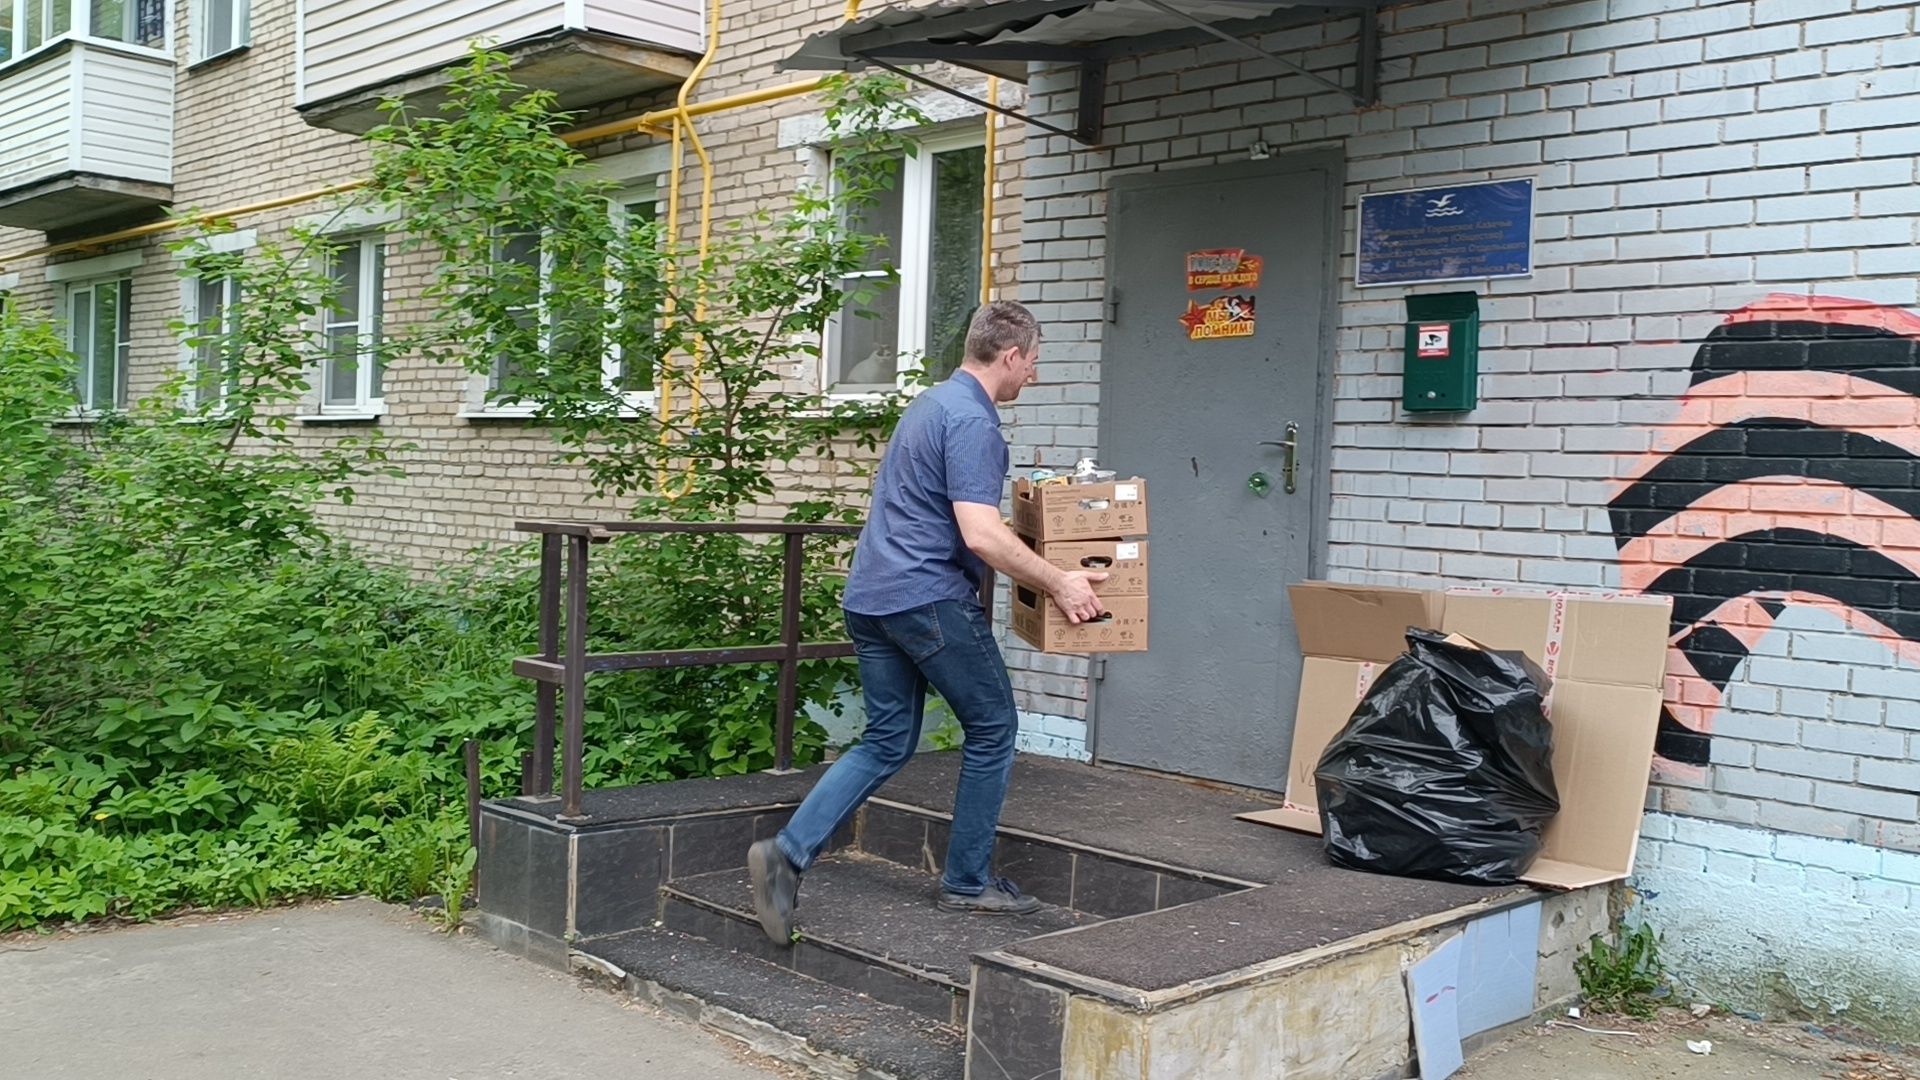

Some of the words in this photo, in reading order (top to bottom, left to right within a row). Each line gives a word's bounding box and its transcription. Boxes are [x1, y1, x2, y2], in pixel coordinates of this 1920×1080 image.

[1222, 273, 1258, 284] КАЖДОГО
[1207, 309, 1229, 322] МЫ
[1194, 321, 1253, 337] ПОМНИМ!
